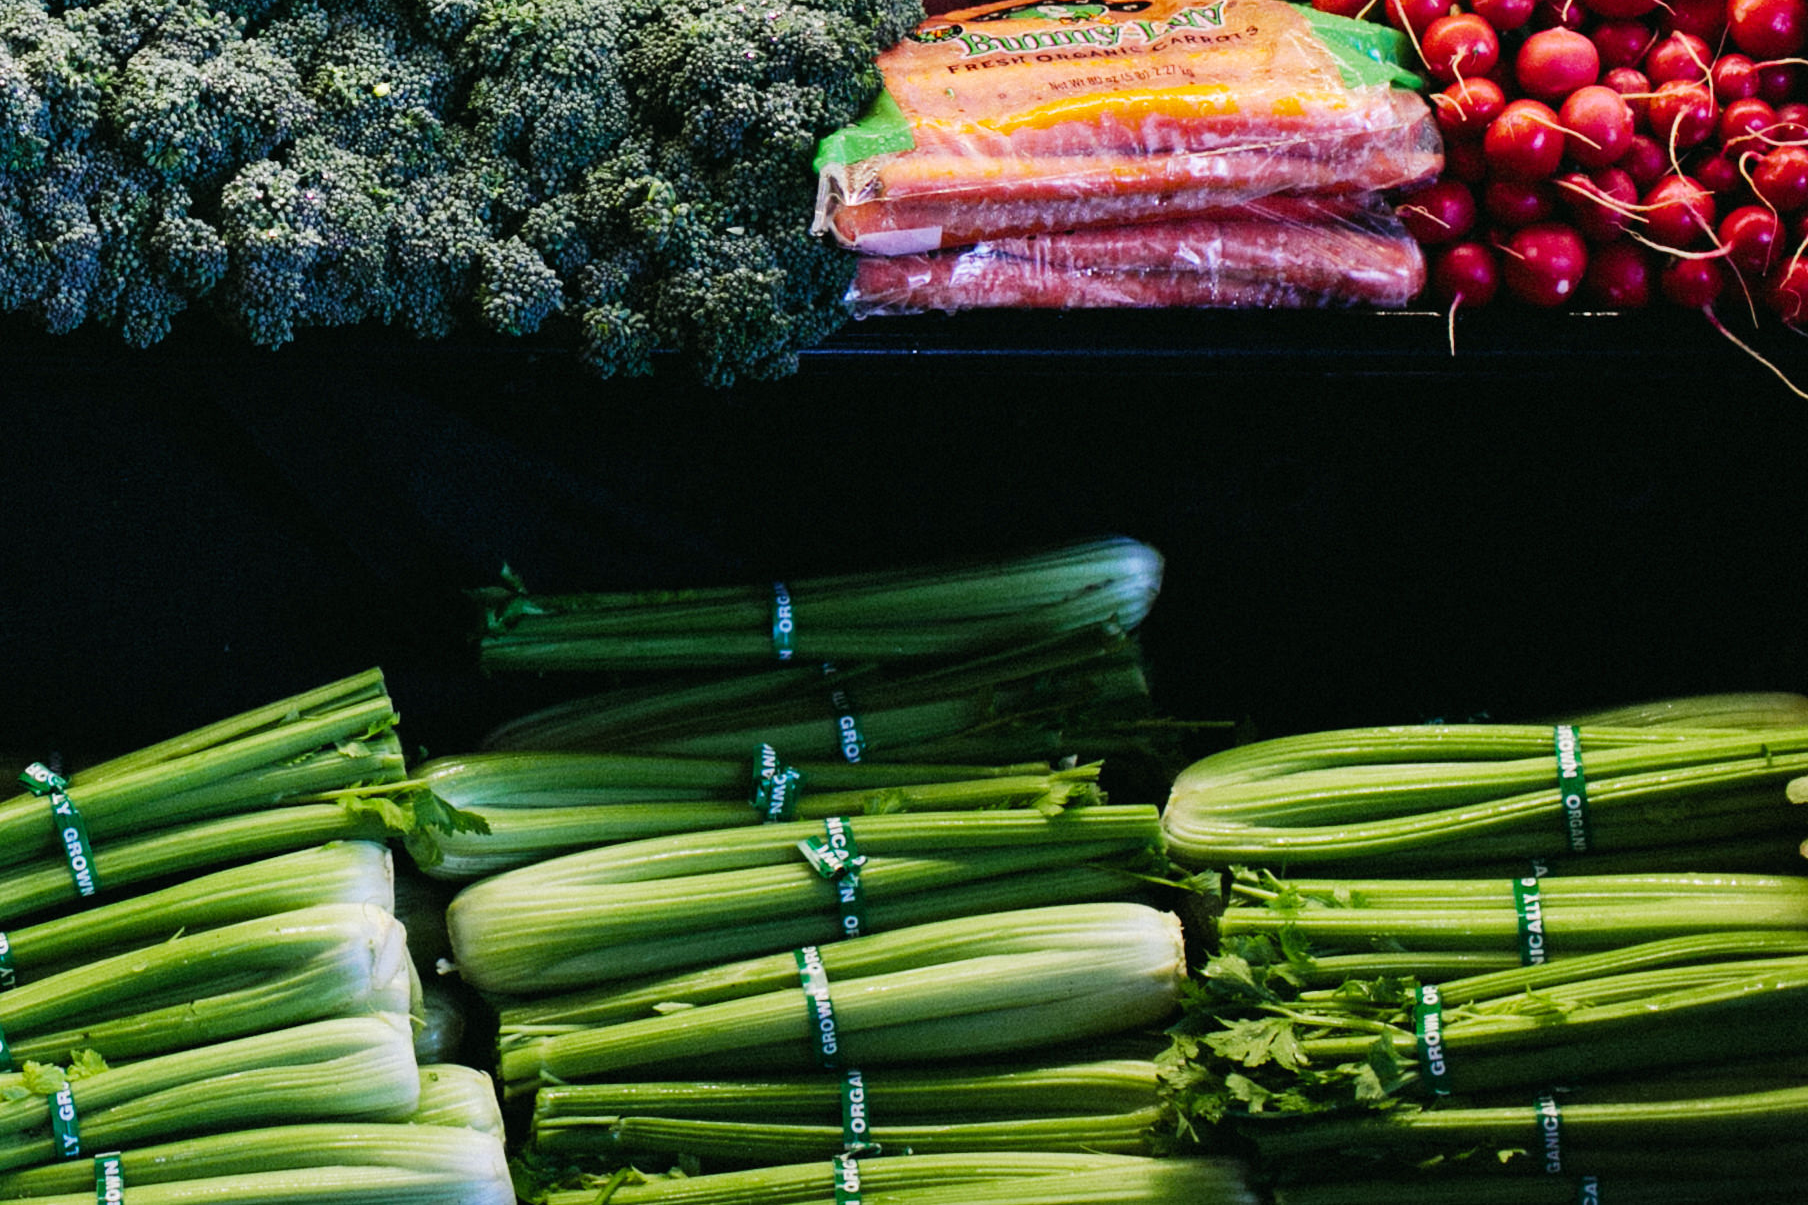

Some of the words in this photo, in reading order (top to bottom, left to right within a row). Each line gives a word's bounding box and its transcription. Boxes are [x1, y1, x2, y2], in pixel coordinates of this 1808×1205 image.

[948, 56, 1026, 75] FRESH
[1036, 46, 1143, 63] ORGANIC
[1152, 25, 1259, 53] CARROTS
[63, 827, 96, 898] GROWN
[1424, 1013, 1446, 1076] GROWN
[104, 1160, 122, 1205] OWN
